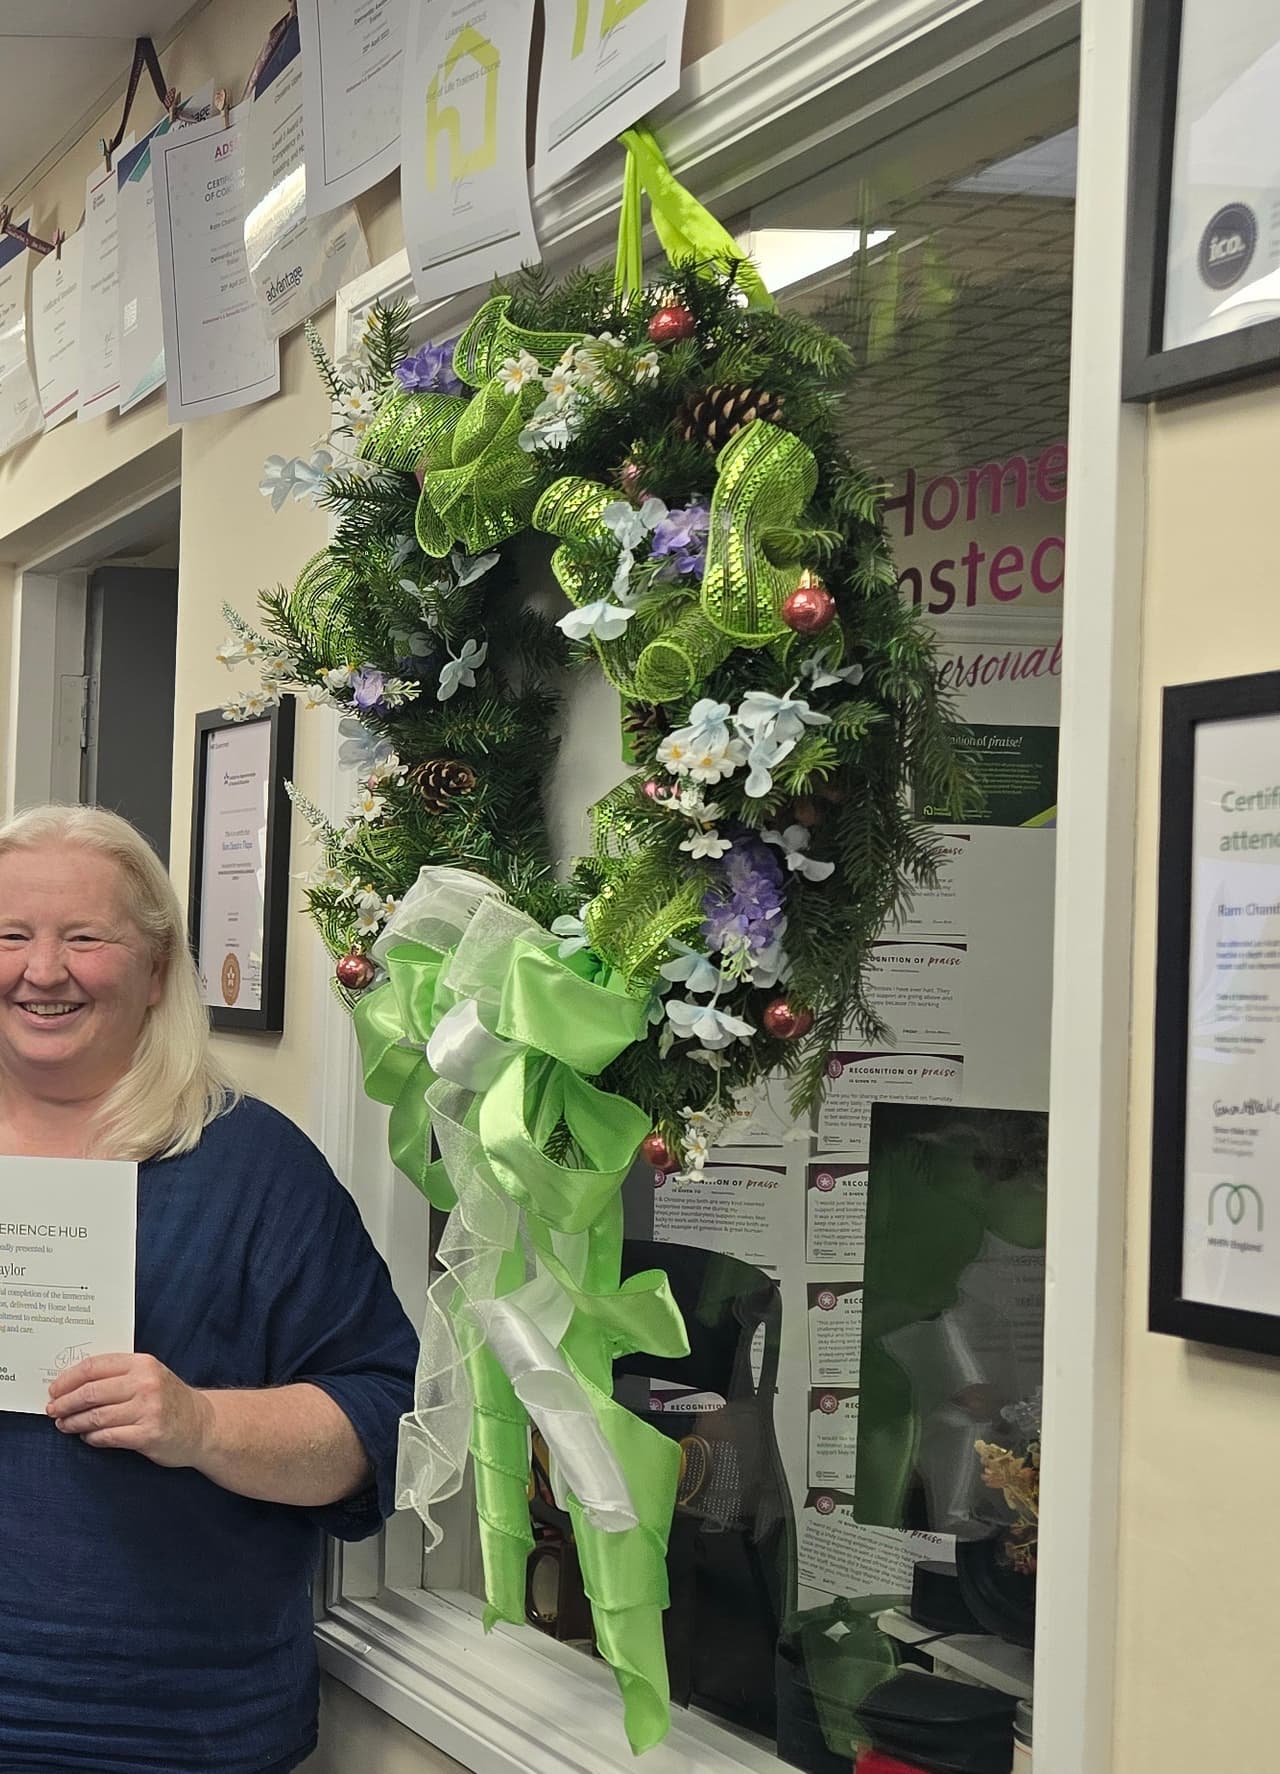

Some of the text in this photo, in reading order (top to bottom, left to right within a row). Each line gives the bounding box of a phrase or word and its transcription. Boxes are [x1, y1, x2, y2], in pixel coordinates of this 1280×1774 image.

[265, 265, 303, 302] advantage
[876, 444, 1067, 537] Home
[896, 537, 1065, 614] nstea
[939, 633, 1062, 690] ersonal
[988, 736, 1023, 749] praise!
[928, 957, 961, 966] praise
[849, 1067, 905, 1075] RECOGNITION
[921, 1069, 955, 1079] praise
[745, 1180, 779, 1189] praise
[59, 1226, 88, 1238] HUB
[15, 1245, 44, 1254] presented
[7, 1288, 41, 1299] completion
[42, 1290, 50, 1298] of
[50, 1291, 61, 1299] the
[9, 1301, 38, 1310] delivered
[38, 1302, 47, 1311] by
[47, 1303, 67, 1312] Home
[31, 1314, 64, 1325] enhancing
[64, 1316, 95, 1326] dementia
[7, 1324, 19, 1333] and
[910, 1530, 943, 1545] praise
